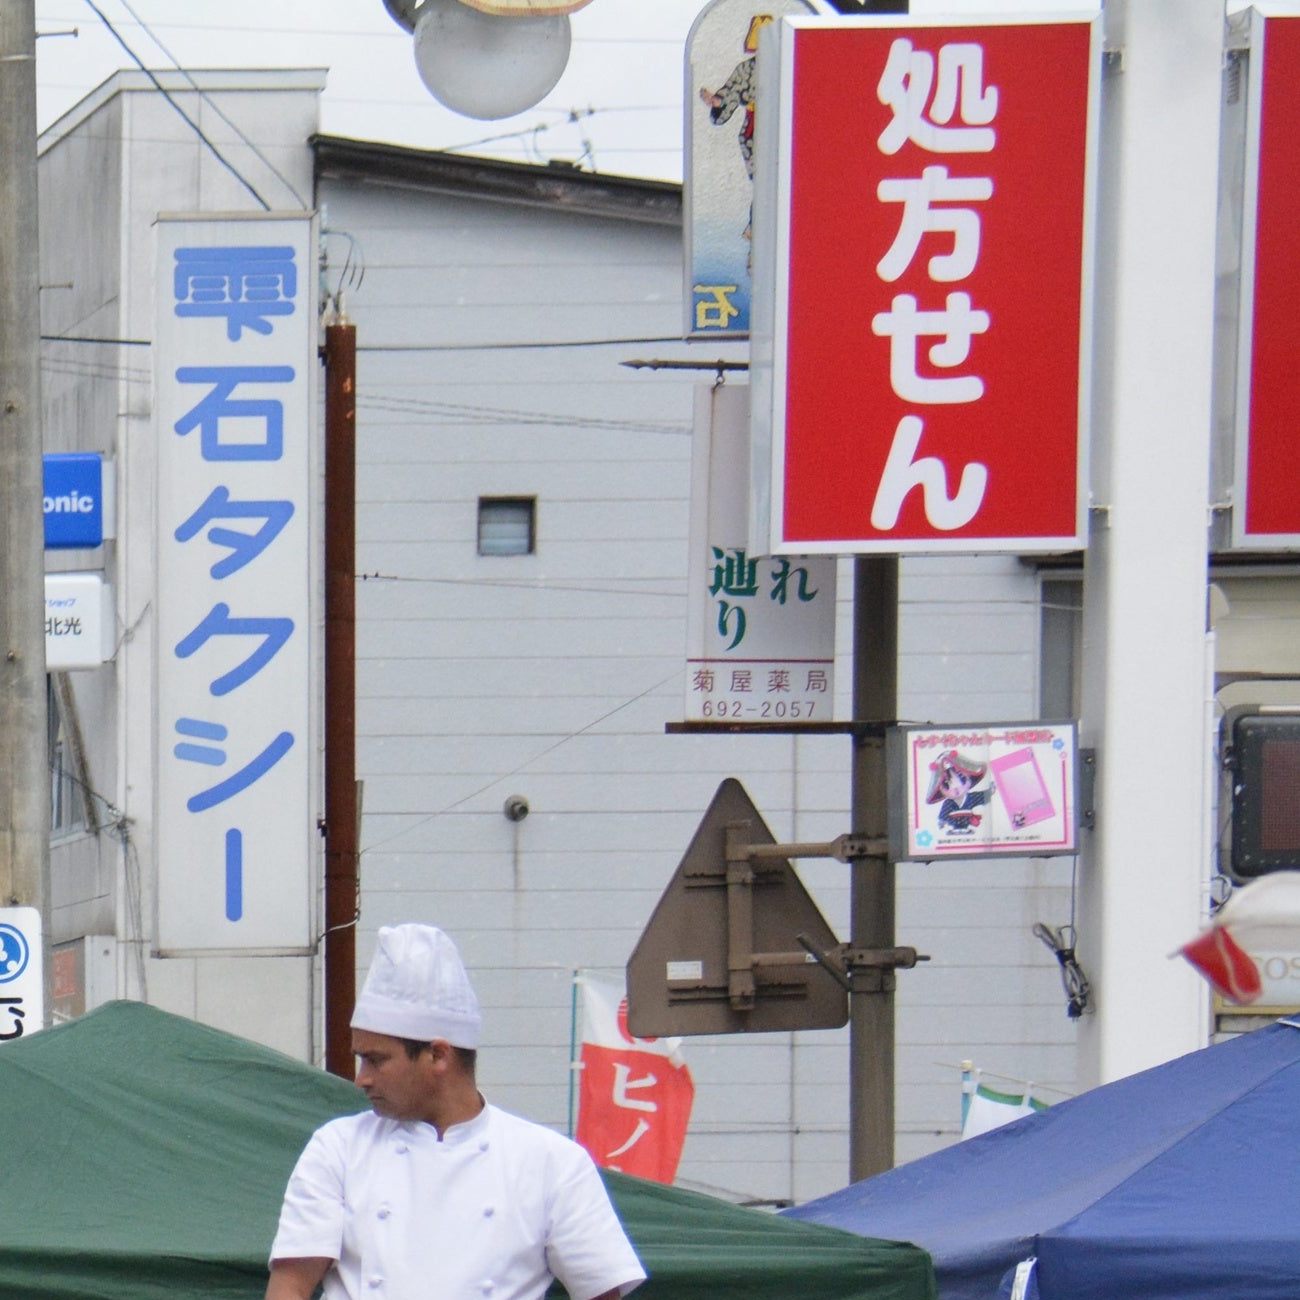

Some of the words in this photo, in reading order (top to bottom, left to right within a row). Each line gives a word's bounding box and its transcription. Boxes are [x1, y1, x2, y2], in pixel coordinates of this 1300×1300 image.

[871, 37, 1000, 532] 処方せん
[172, 244, 300, 924] 雫石タクシー
[692, 669, 828, 693] 菊屋薬局
[701, 700, 817, 720] 692-2057
[606, 1062, 658, 1172] ヒノ
